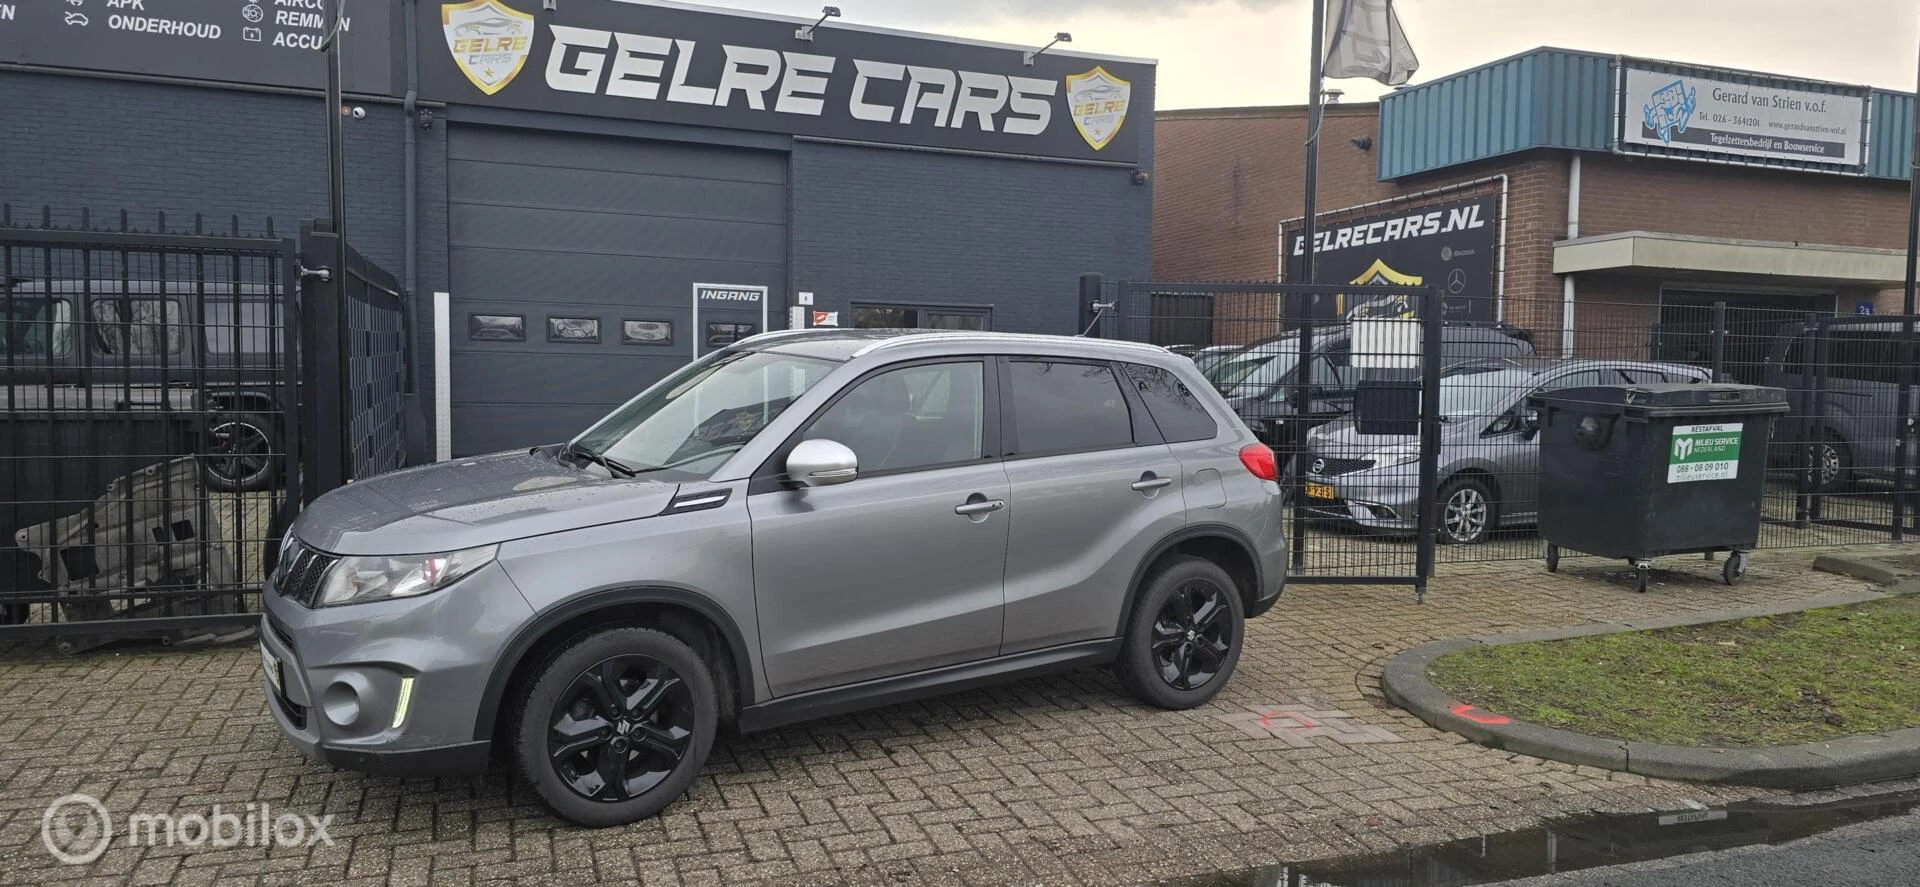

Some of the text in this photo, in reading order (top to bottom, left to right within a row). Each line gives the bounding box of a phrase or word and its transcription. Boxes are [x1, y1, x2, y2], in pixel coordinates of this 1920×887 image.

[108, 14, 222, 40] ONDERHOUD
[275, 10, 351, 31] REMMN
[272, 31, 323, 50] ACCU
[453, 36, 528, 53] GELRE
[469, 52, 513, 65] CARS
[545, 24, 1058, 136] GELRE CARS
[1073, 99, 1126, 116] GELRE
[1712, 87, 1827, 113] Gerard van Strien v.o.f.
[1699, 112, 1709, 121] Tel.
[1713, 113, 1726, 123] 026
[1733, 115, 1760, 127] 3641201
[1768, 120, 1847, 135] www.gerardvanstrien-vof.nl
[1710, 132, 1825, 154] Tegelzettersbedrijf en Bouwservice
[1293, 204, 1485, 256] GELRECARS.NL
[700, 290, 760, 301] INGANG
[1691, 425, 1724, 433] RESTAFVAL
[1694, 445, 1725, 453] NEDERLAND
[1714, 437, 1739, 445] SERVICE
[1676, 464, 1689, 474] 088
[1694, 463, 1703, 472] 08
[1705, 463, 1713, 471] 09
[1715, 462, 1729, 471] 010
